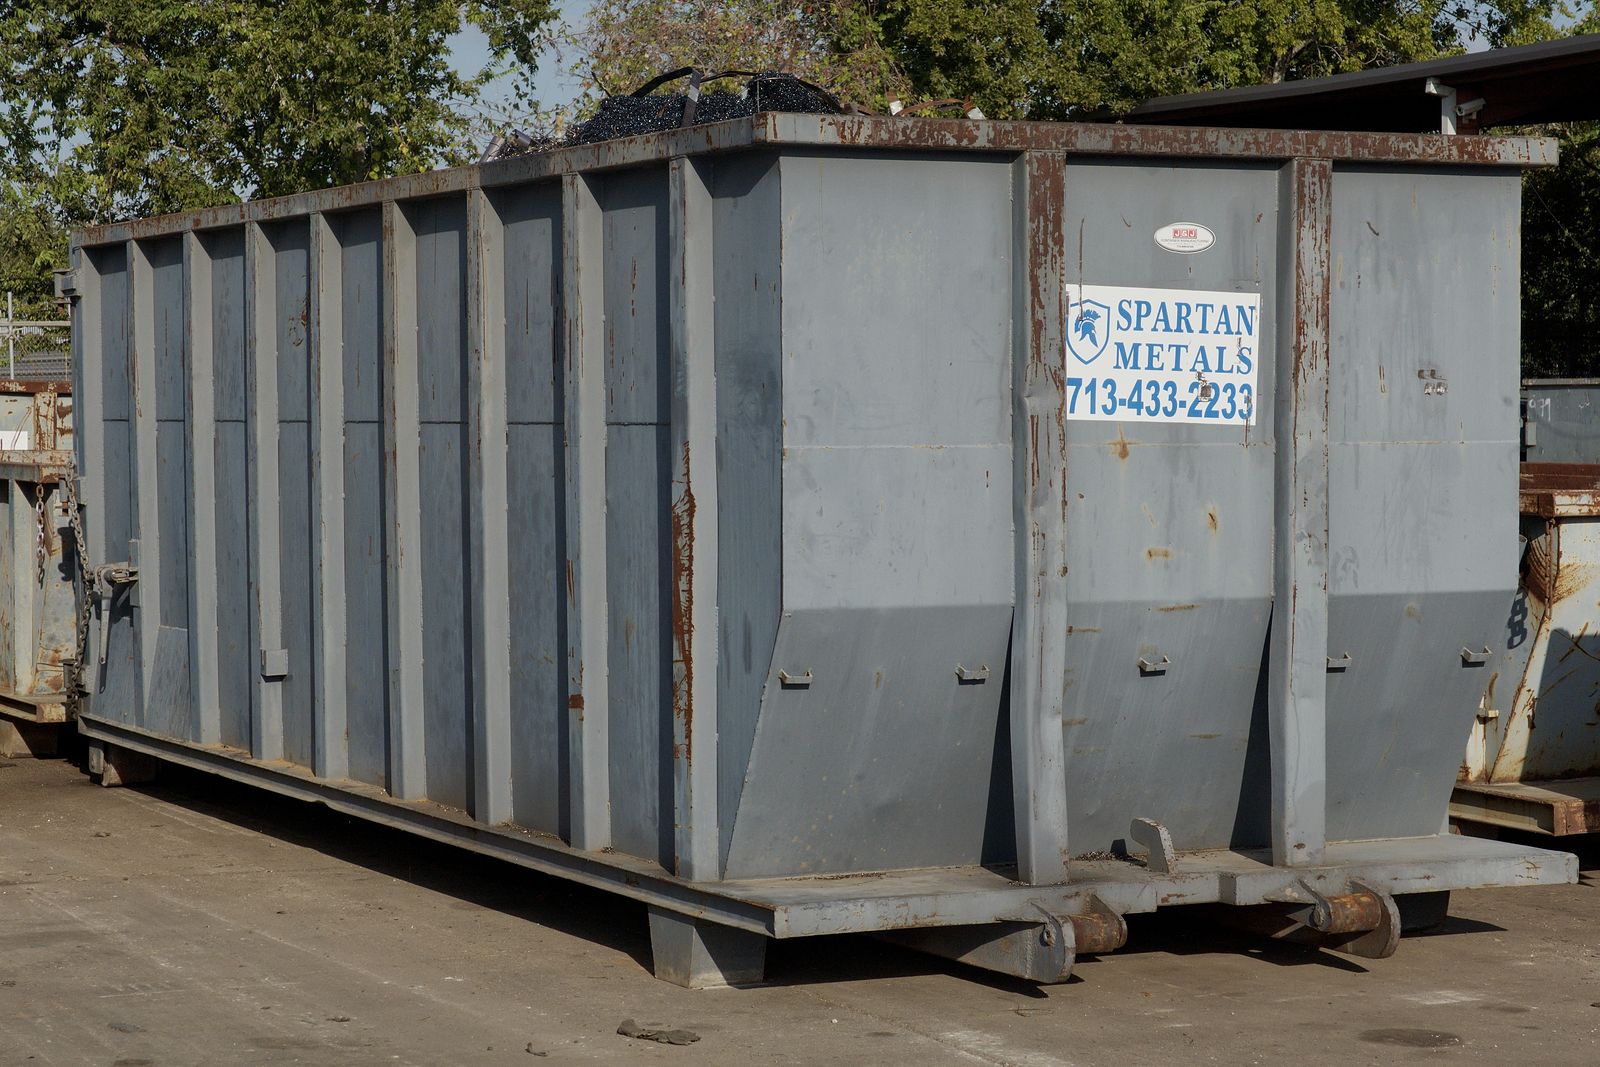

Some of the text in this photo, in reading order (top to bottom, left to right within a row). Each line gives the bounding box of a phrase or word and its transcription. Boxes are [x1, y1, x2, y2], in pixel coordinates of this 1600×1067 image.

[1117, 299, 1255, 336] SPARTAN
[1113, 341, 1253, 375] METALS
[1066, 377, 1252, 420] 713-433-2233
